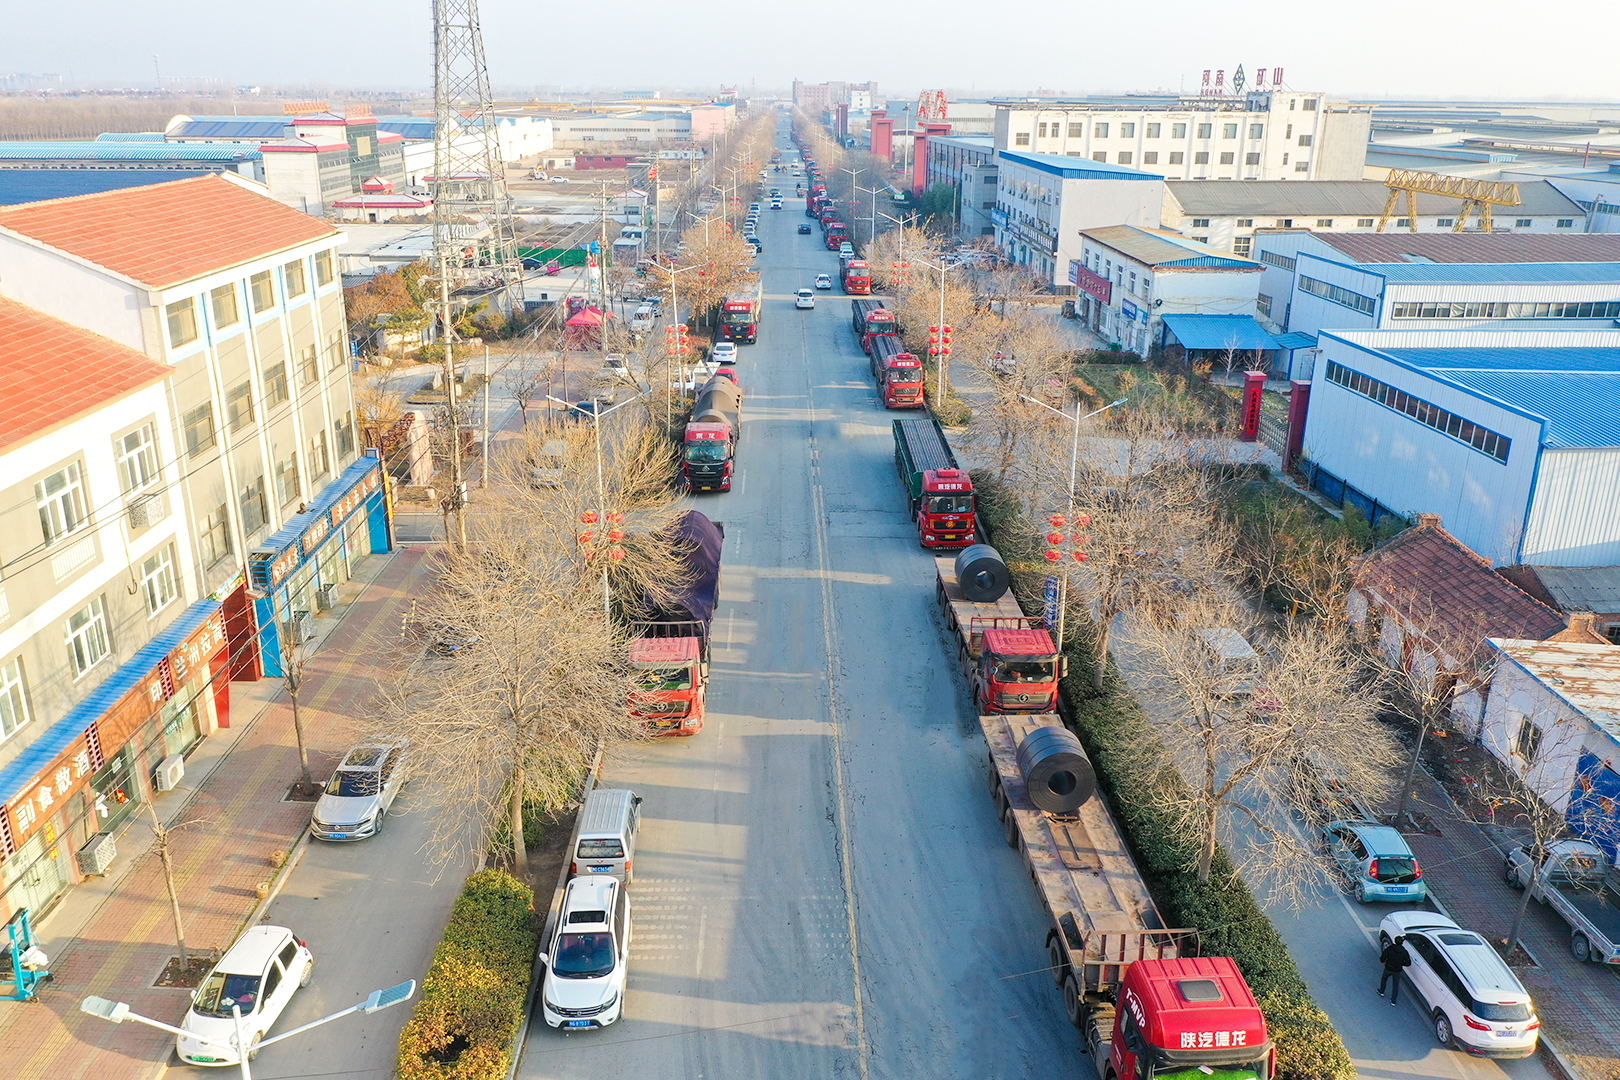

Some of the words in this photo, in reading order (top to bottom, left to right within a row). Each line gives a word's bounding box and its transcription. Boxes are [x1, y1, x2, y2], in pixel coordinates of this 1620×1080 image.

[175, 621, 223, 680] 兰州拉面
[151, 680, 163, 702] 印
[1126, 988, 1146, 1028] T-MVP
[1180, 1030, 1247, 1048] 陕汽德龙
